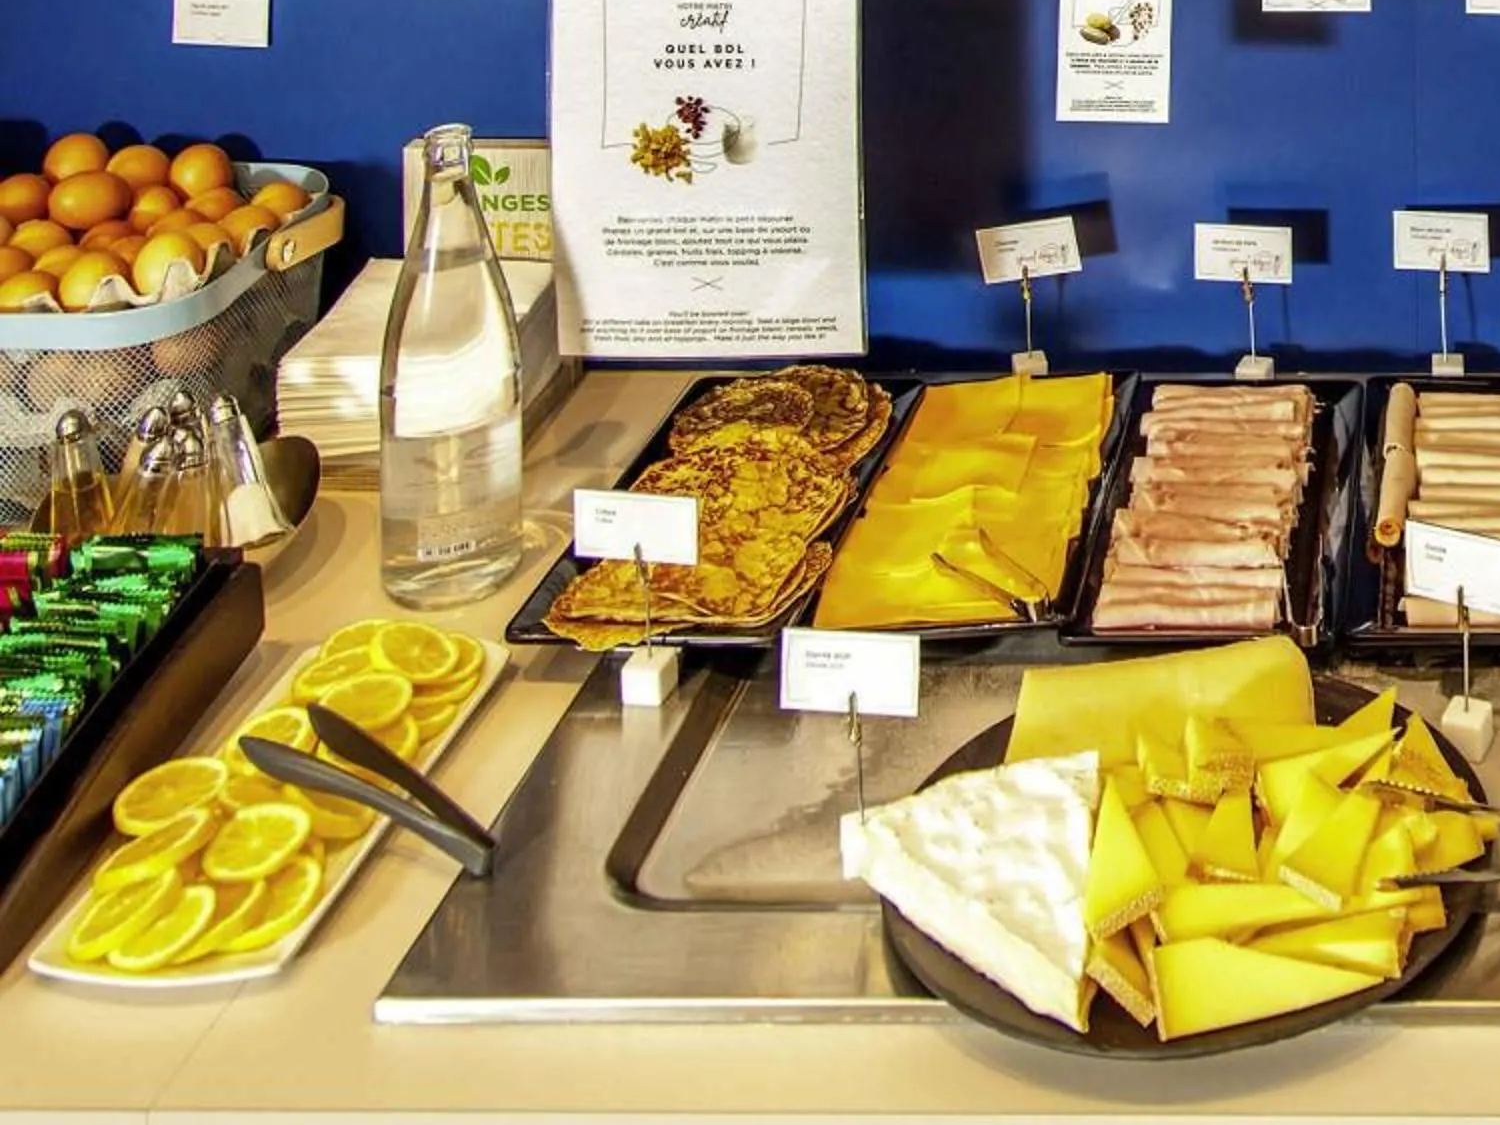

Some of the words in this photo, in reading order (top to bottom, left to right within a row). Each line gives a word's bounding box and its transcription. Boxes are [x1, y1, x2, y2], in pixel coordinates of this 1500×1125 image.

[665, 44, 706, 55] QUEL
[714, 44, 744, 55] BOL
[653, 58, 695, 70] VOUS
[703, 58, 743, 70] AVEZ
